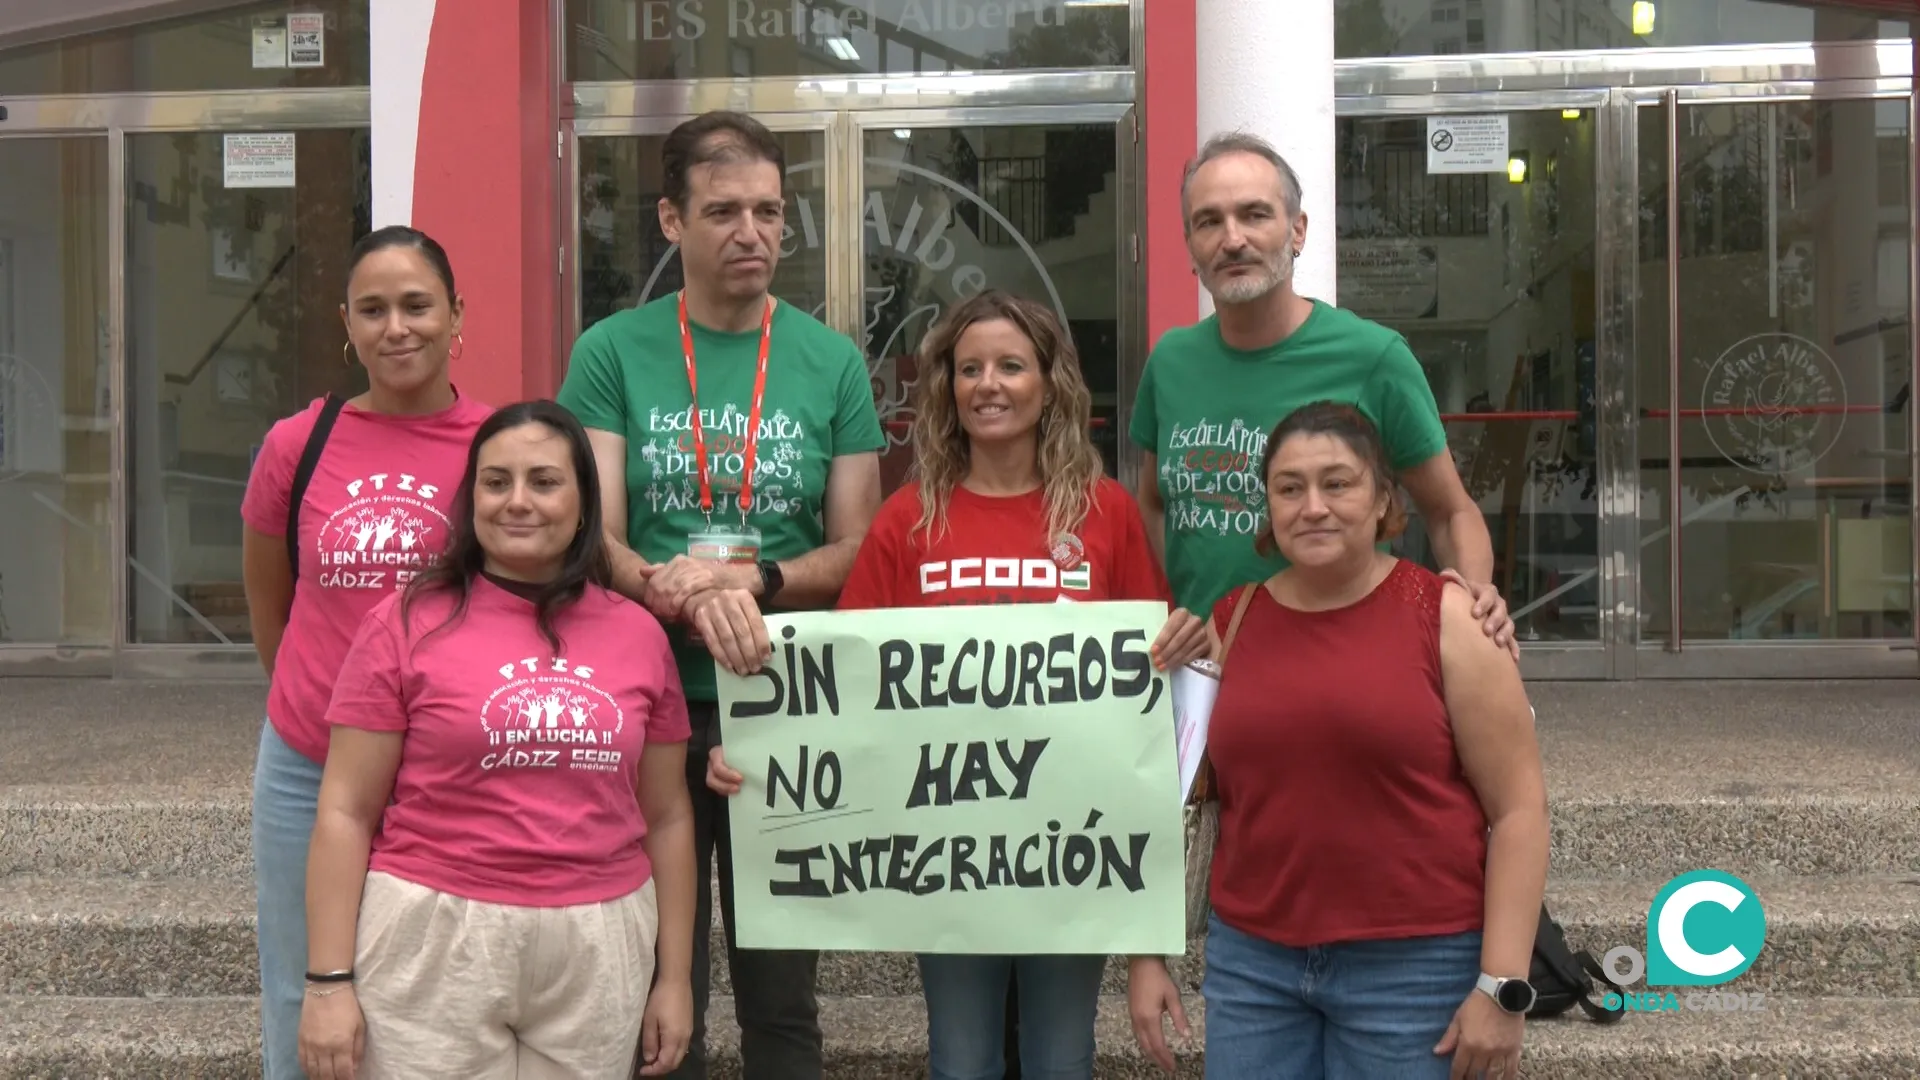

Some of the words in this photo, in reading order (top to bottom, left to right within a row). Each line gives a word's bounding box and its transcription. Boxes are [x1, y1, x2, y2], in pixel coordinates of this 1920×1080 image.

[625, 0, 706, 41] IES
[727, 0, 877, 38] Rafael
[1713, 344, 1766, 405] Rafael
[1774, 342, 1836, 403] Alberti
[1169, 420, 1237, 451] ESCUELA
[1185, 450, 1248, 472] CCOO
[346, 473, 439, 499] PTIS
[1176, 472, 1215, 494] DE
[333, 551, 356, 565] EN
[361, 551, 421, 566] LUCHA
[319, 566, 386, 589] CÁDIZ
[920, 557, 1057, 594] CCOO
[498, 656, 594, 681] PTIS
[874, 628, 1164, 714] RECURSOS,
[505, 729, 530, 744] EN
[536, 729, 597, 744] LUCHA
[480, 746, 561, 770] CÁDIZ
[571, 749, 622, 763] CCOO
[766, 744, 842, 812] NO
[905, 737, 1051, 809] HAY
